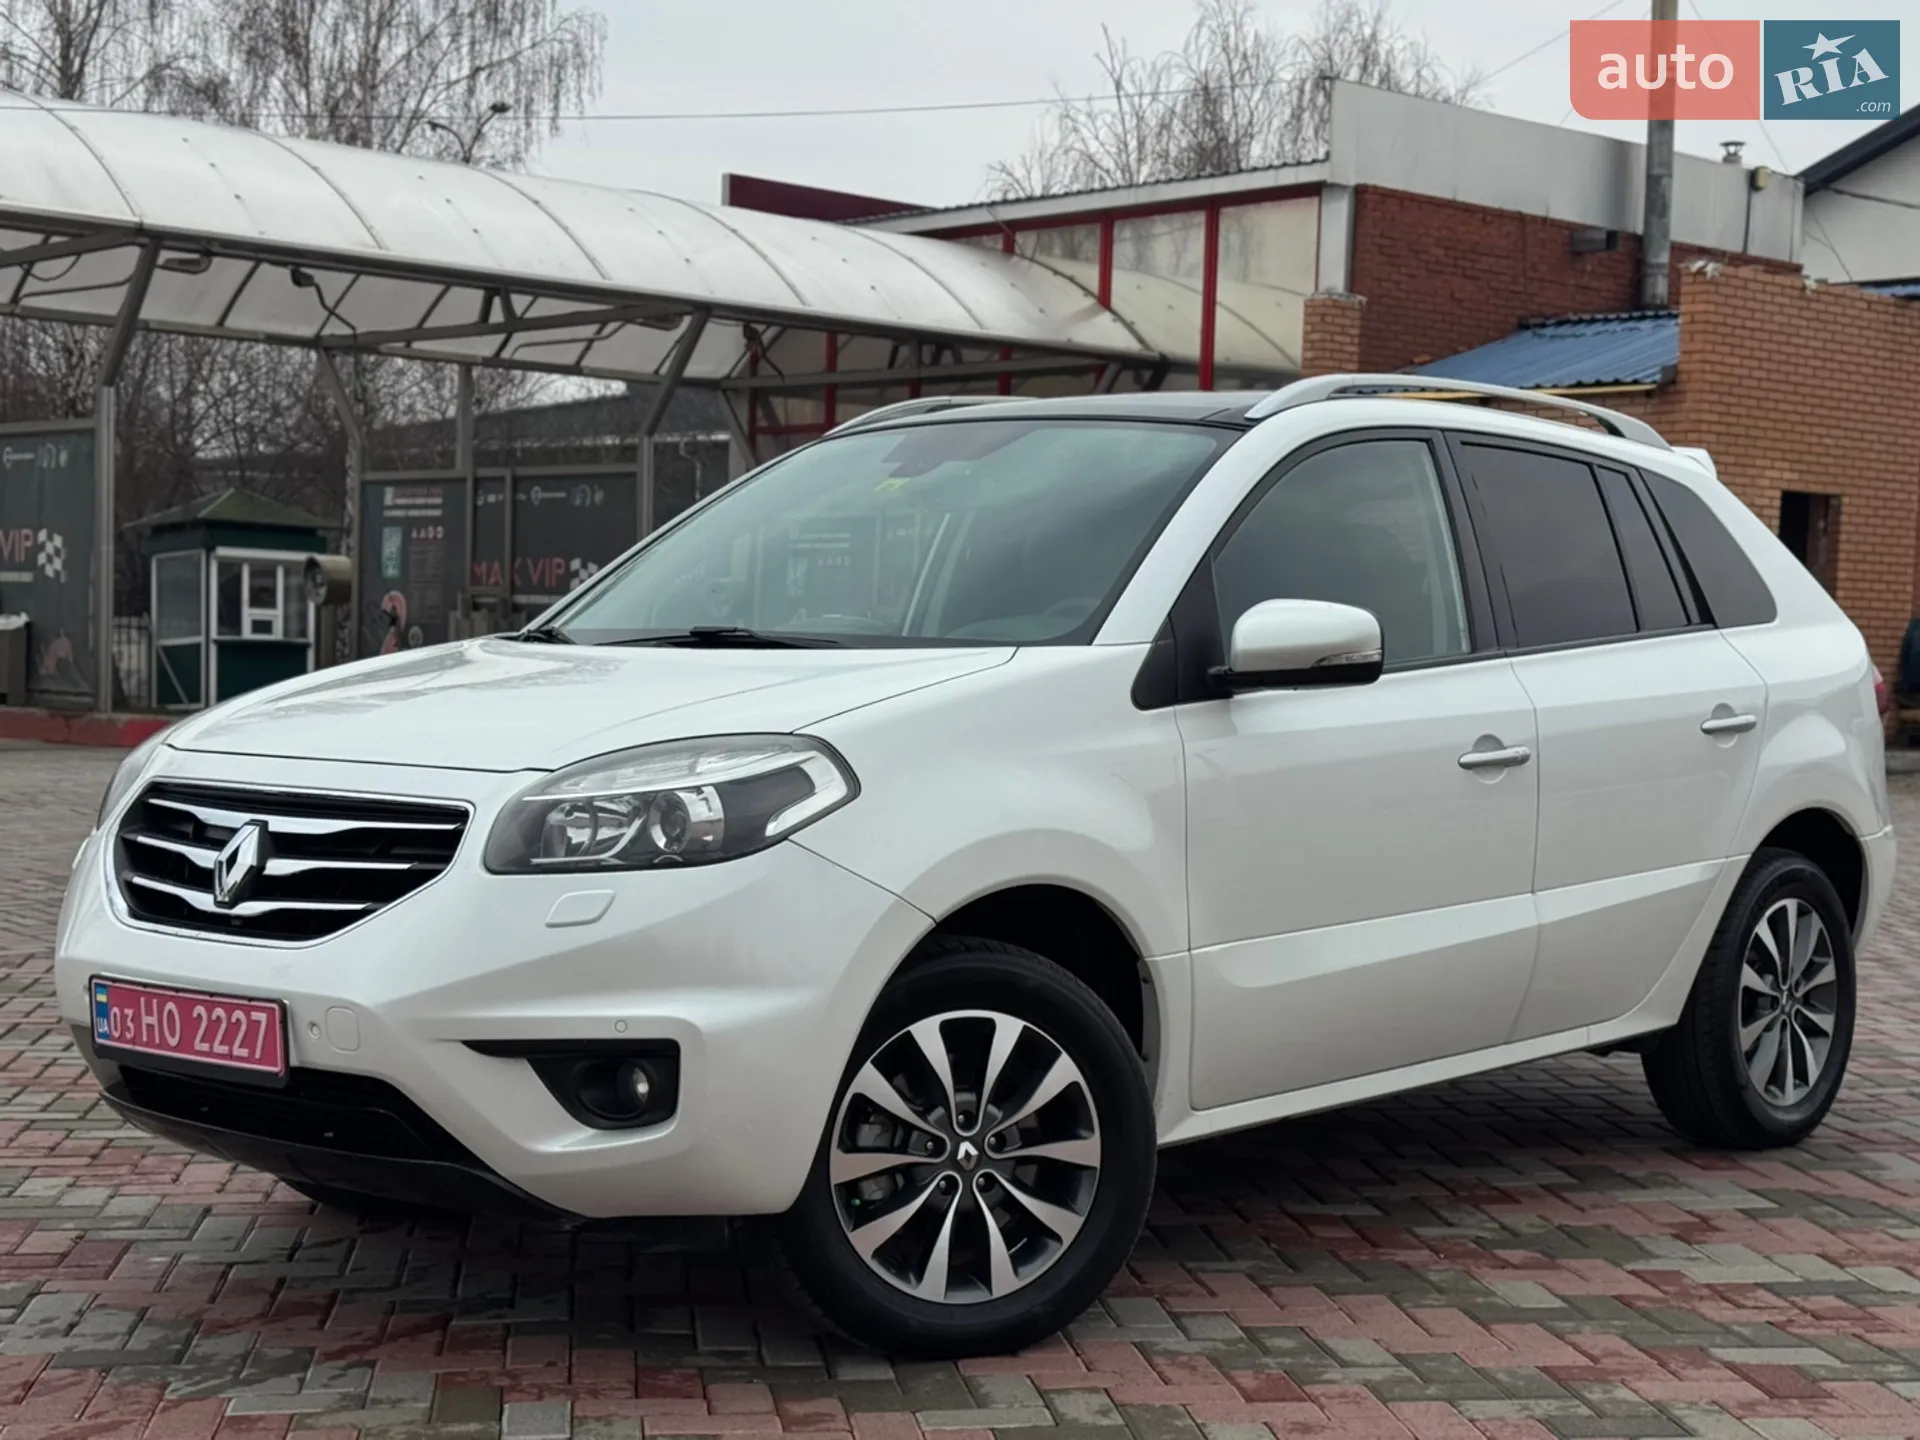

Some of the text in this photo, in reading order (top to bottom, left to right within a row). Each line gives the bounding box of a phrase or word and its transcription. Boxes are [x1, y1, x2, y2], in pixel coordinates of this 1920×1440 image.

[0, 527, 34, 564] VIP
[527, 556, 567, 588] VIP
[96, 1016, 110, 1035] UA
[191, 1004, 268, 1060] 2227
